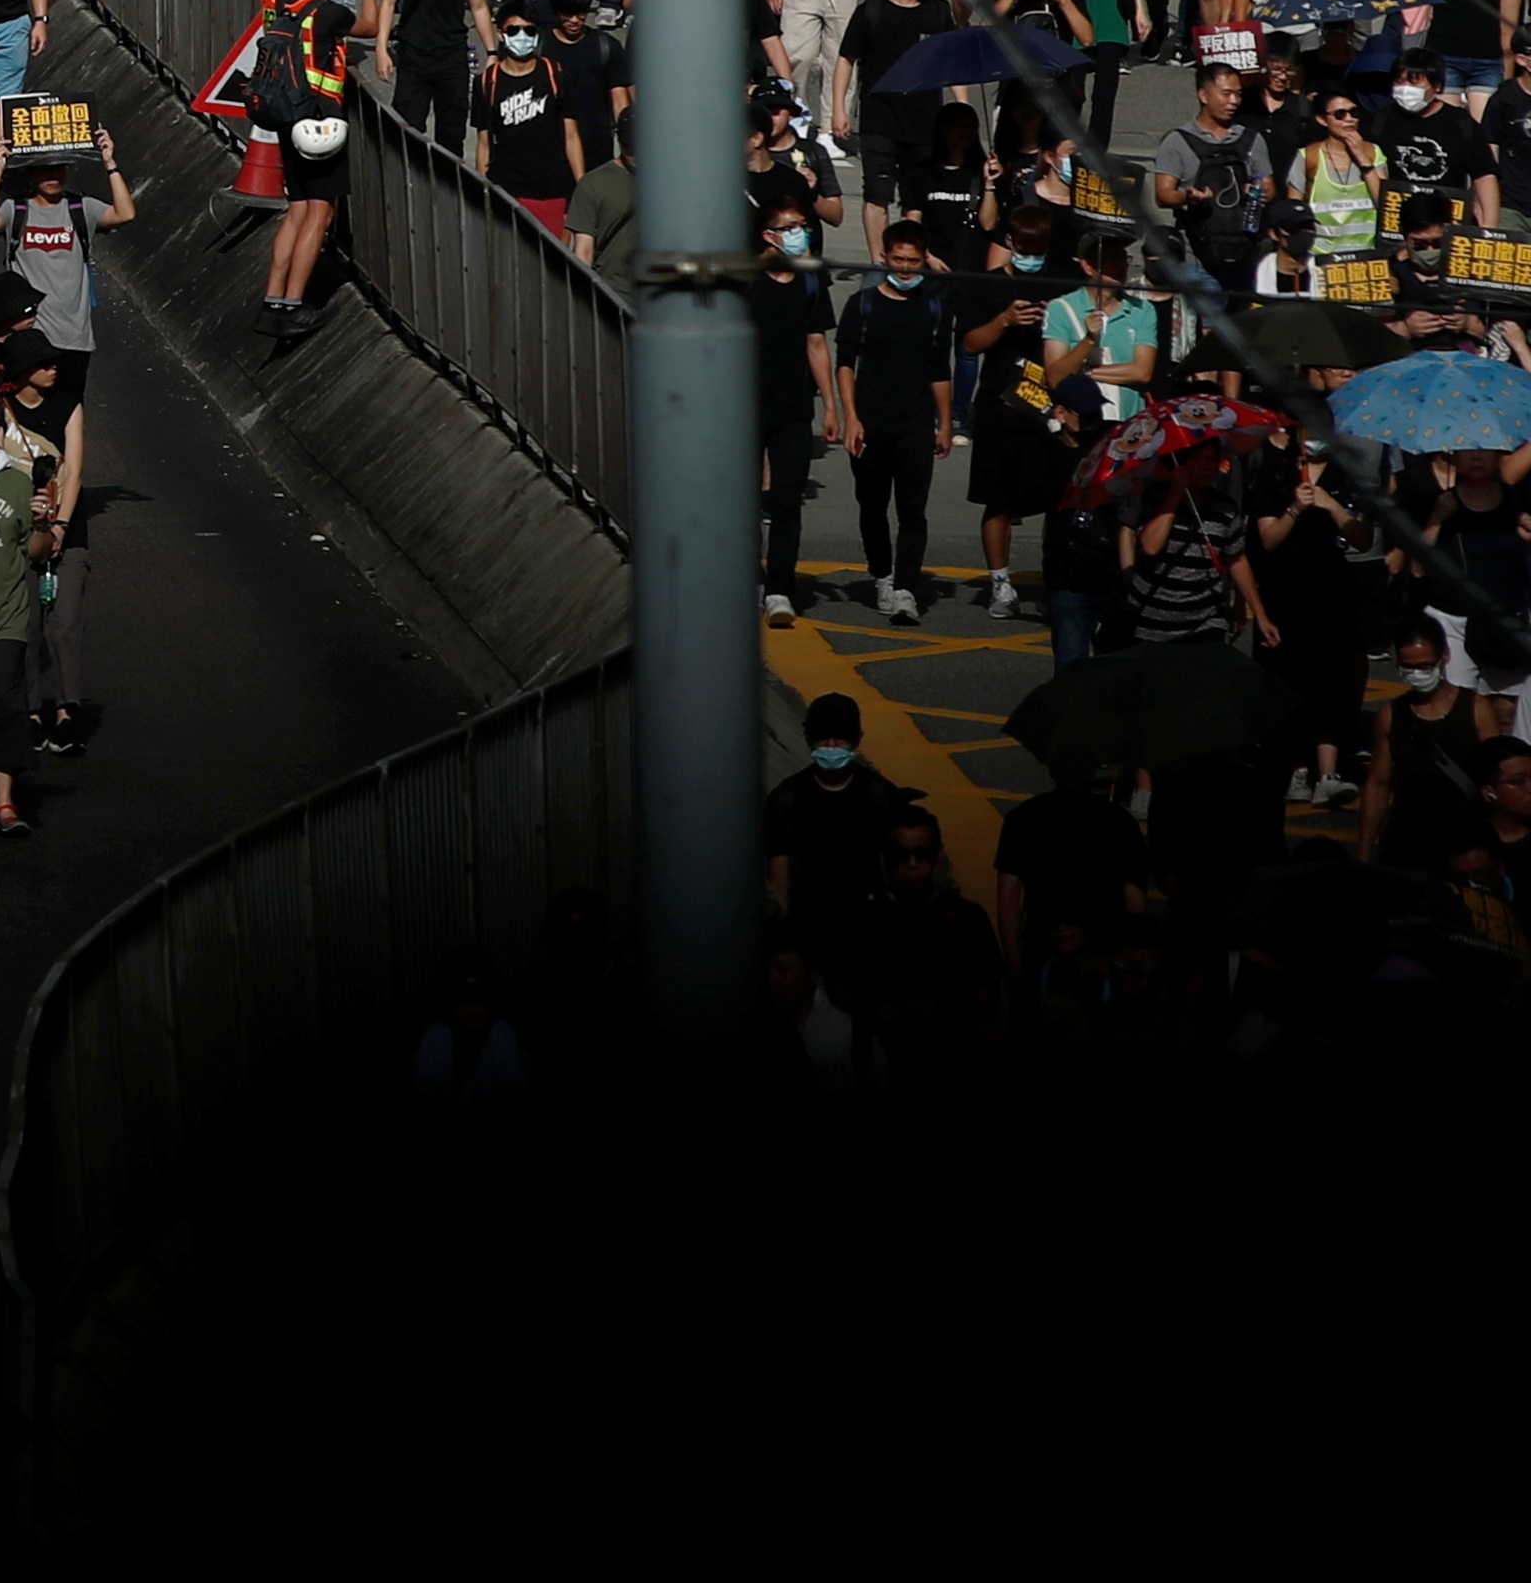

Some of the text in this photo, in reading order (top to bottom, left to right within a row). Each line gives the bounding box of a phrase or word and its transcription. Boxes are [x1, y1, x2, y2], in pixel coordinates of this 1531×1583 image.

[1198, 31, 1256, 53] 平反暴動
[12, 103, 90, 127] 全面撤回
[12, 122, 93, 147] 送中惡法
[1450, 234, 1531, 262] 全面撤回
[1449, 255, 1531, 286] 送中惡法
